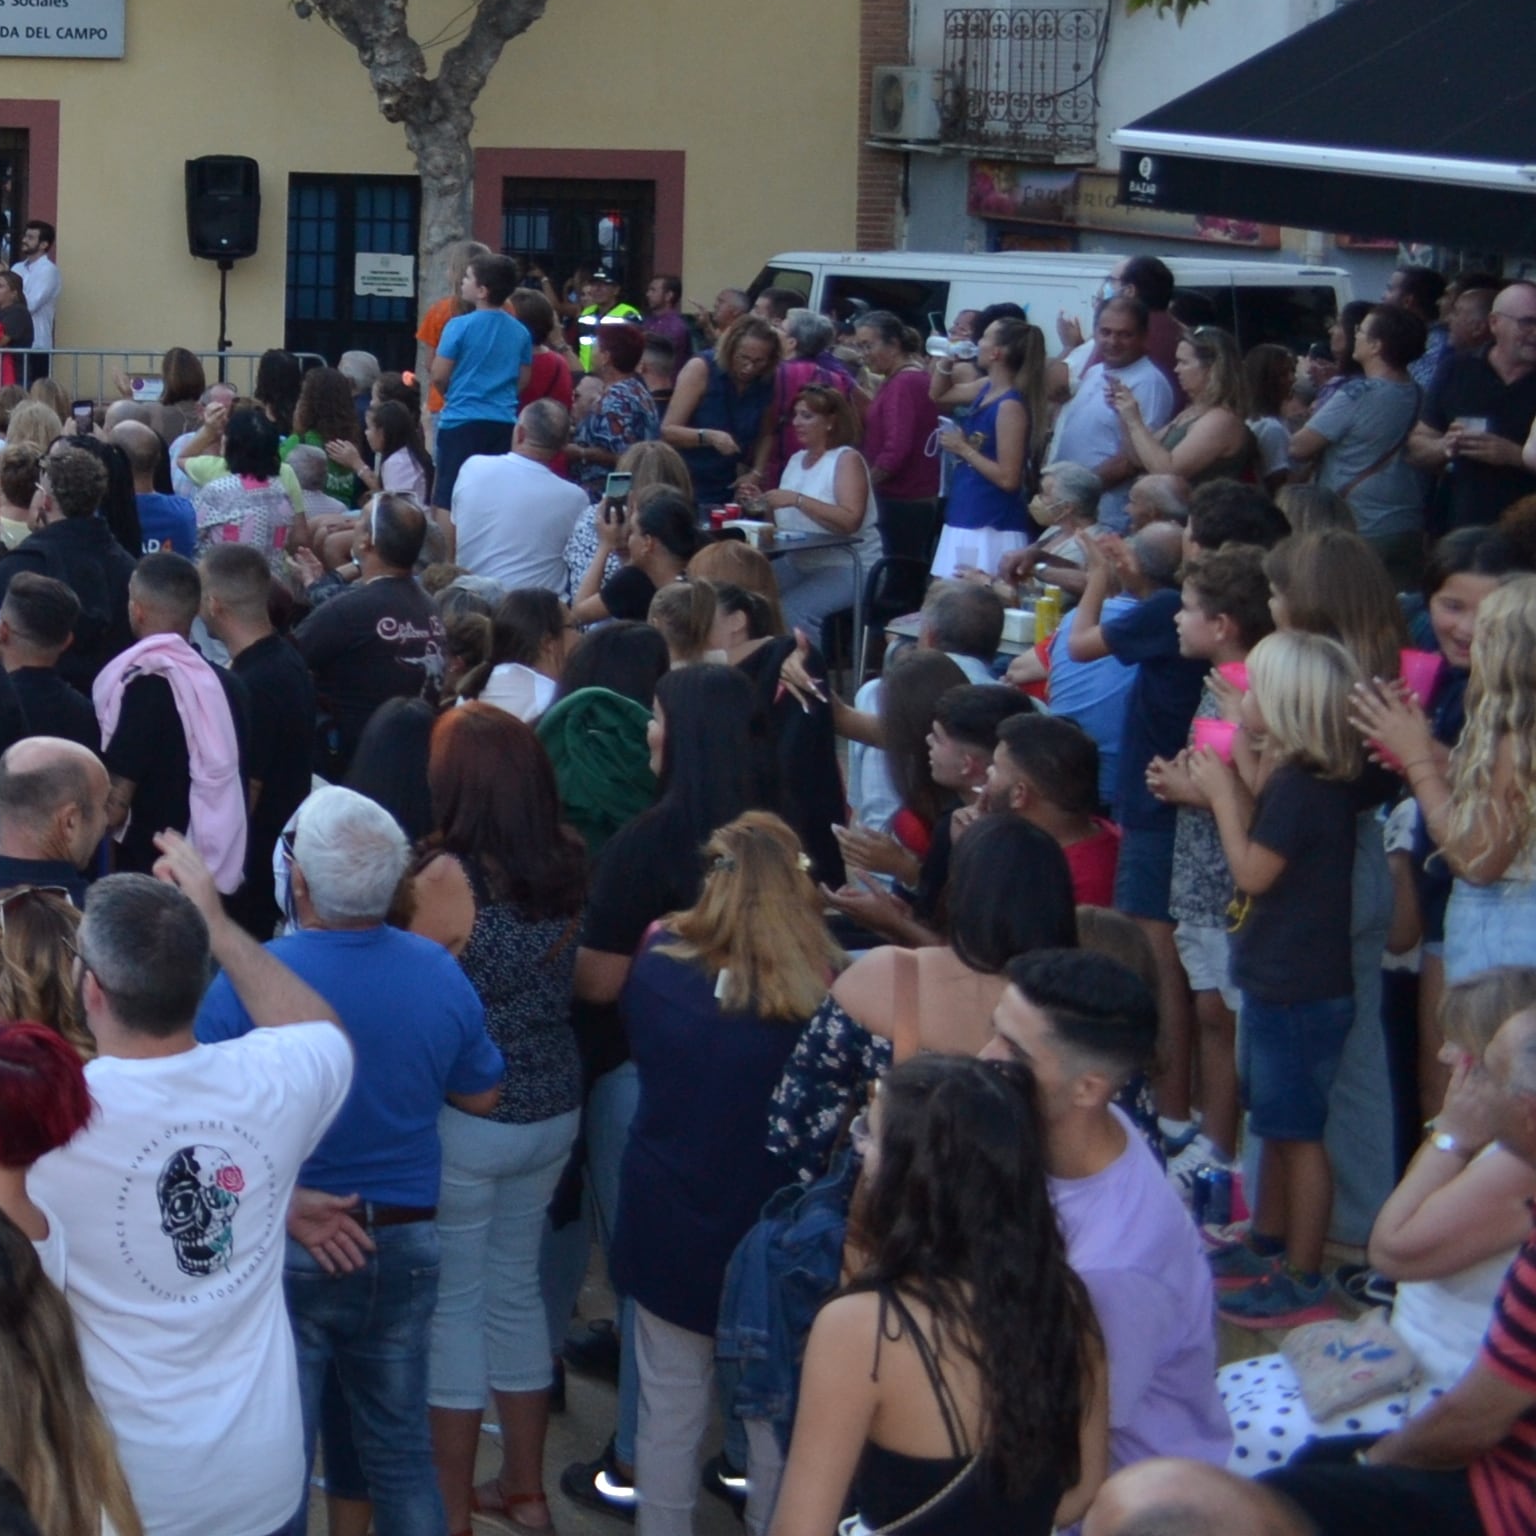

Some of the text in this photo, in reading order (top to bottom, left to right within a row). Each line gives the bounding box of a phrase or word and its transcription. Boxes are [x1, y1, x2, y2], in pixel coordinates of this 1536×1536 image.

[25, 26, 50, 39] DEL
[55, 27, 108, 40] CAMPO
[199, 1120, 225, 1130] THE
